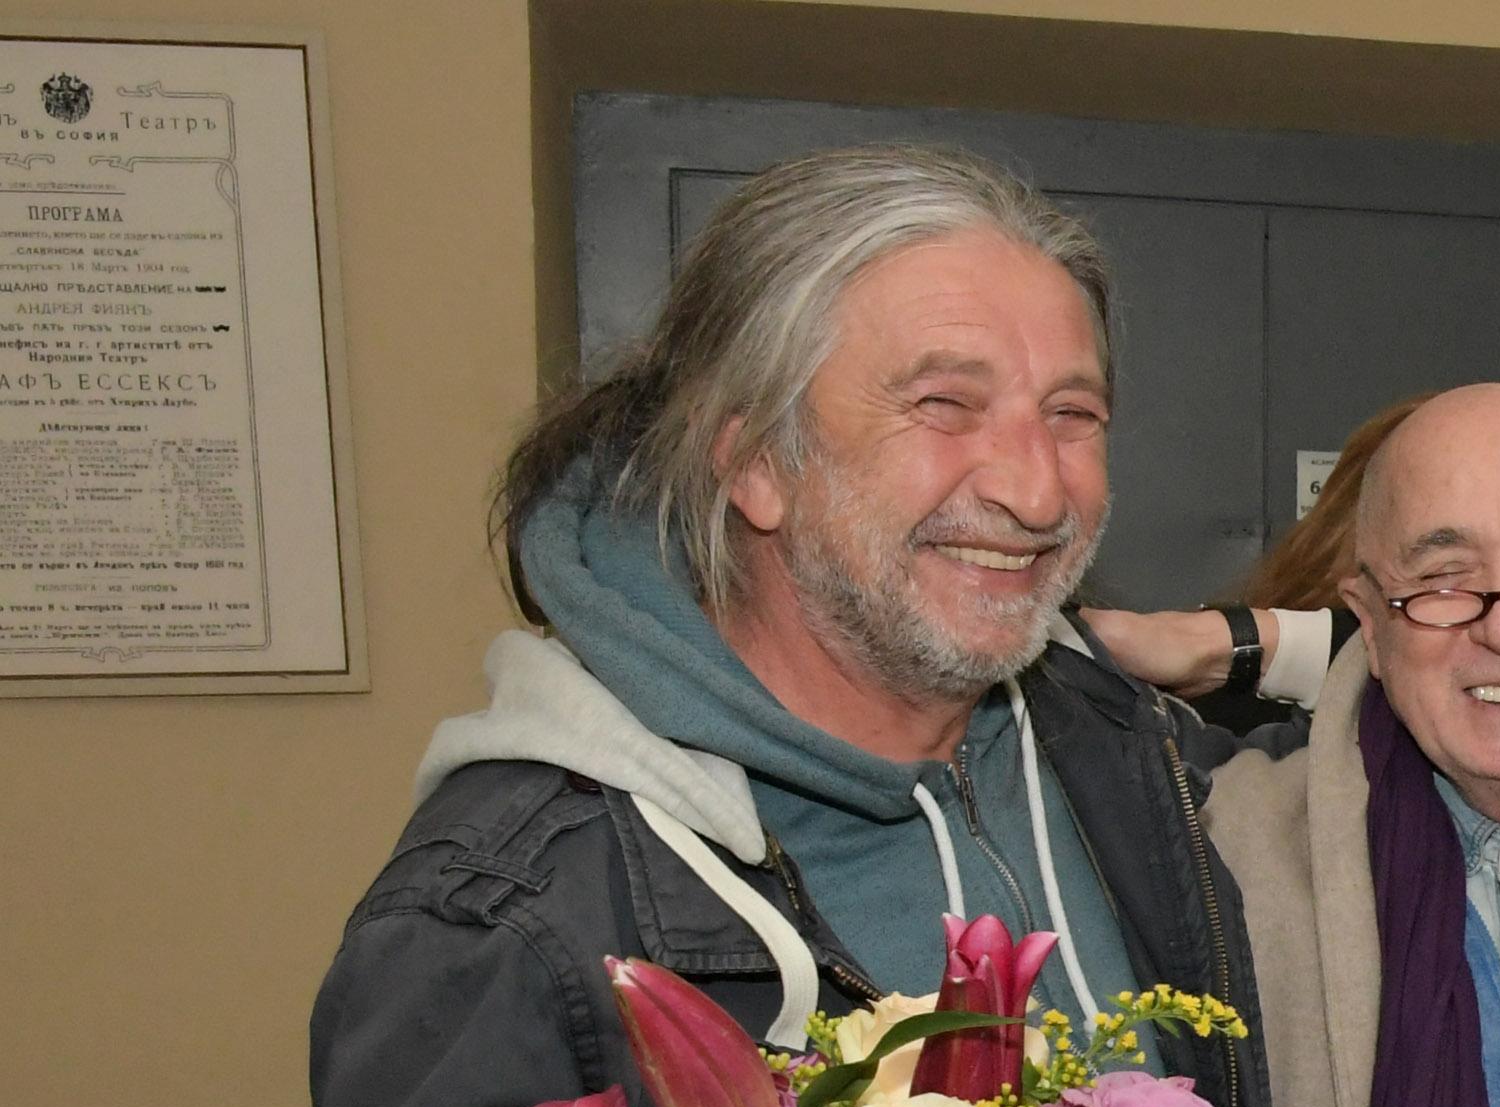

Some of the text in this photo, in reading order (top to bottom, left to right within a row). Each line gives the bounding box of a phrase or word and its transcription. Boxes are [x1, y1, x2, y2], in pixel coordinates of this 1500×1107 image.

[120, 111, 217, 134] Театръ
[27, 204, 124, 222] ПРОГРАМА
[16, 302, 83, 315] АНДРЕЯ
[99, 352, 148, 365] Театръ
[78, 372, 217, 391] ЕССЕКСЪ
[1309, 480, 1321, 495] 6
